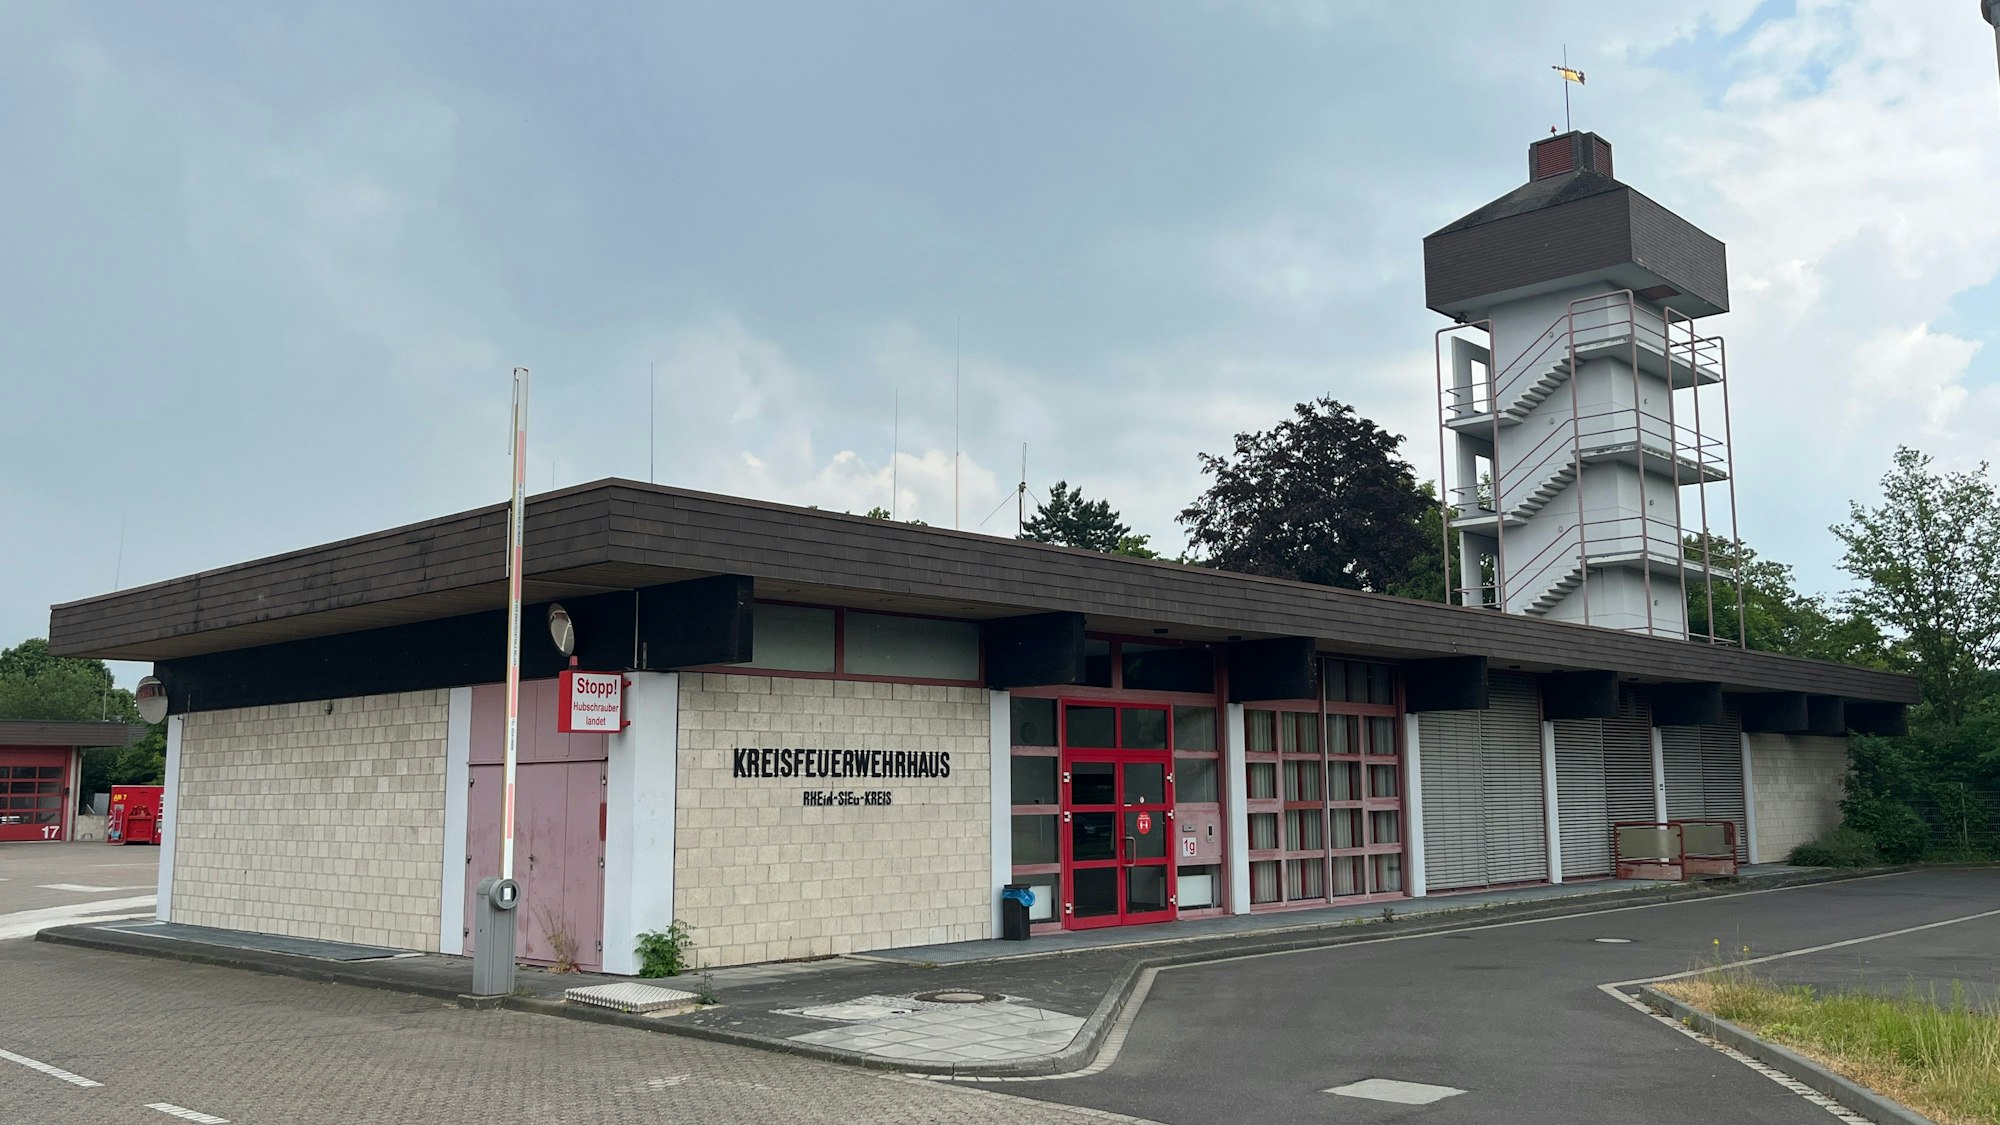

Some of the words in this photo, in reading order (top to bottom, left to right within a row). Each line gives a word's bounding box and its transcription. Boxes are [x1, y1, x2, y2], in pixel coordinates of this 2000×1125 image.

[576, 677, 617, 698] Stopp!
[573, 701, 619, 713] Hubschrauber
[585, 715, 606, 726] landet
[733, 748, 951, 778] KREISFEUERWEHRHAUS
[41, 825, 60, 839] 17
[1184, 839, 1195, 855] 1g
